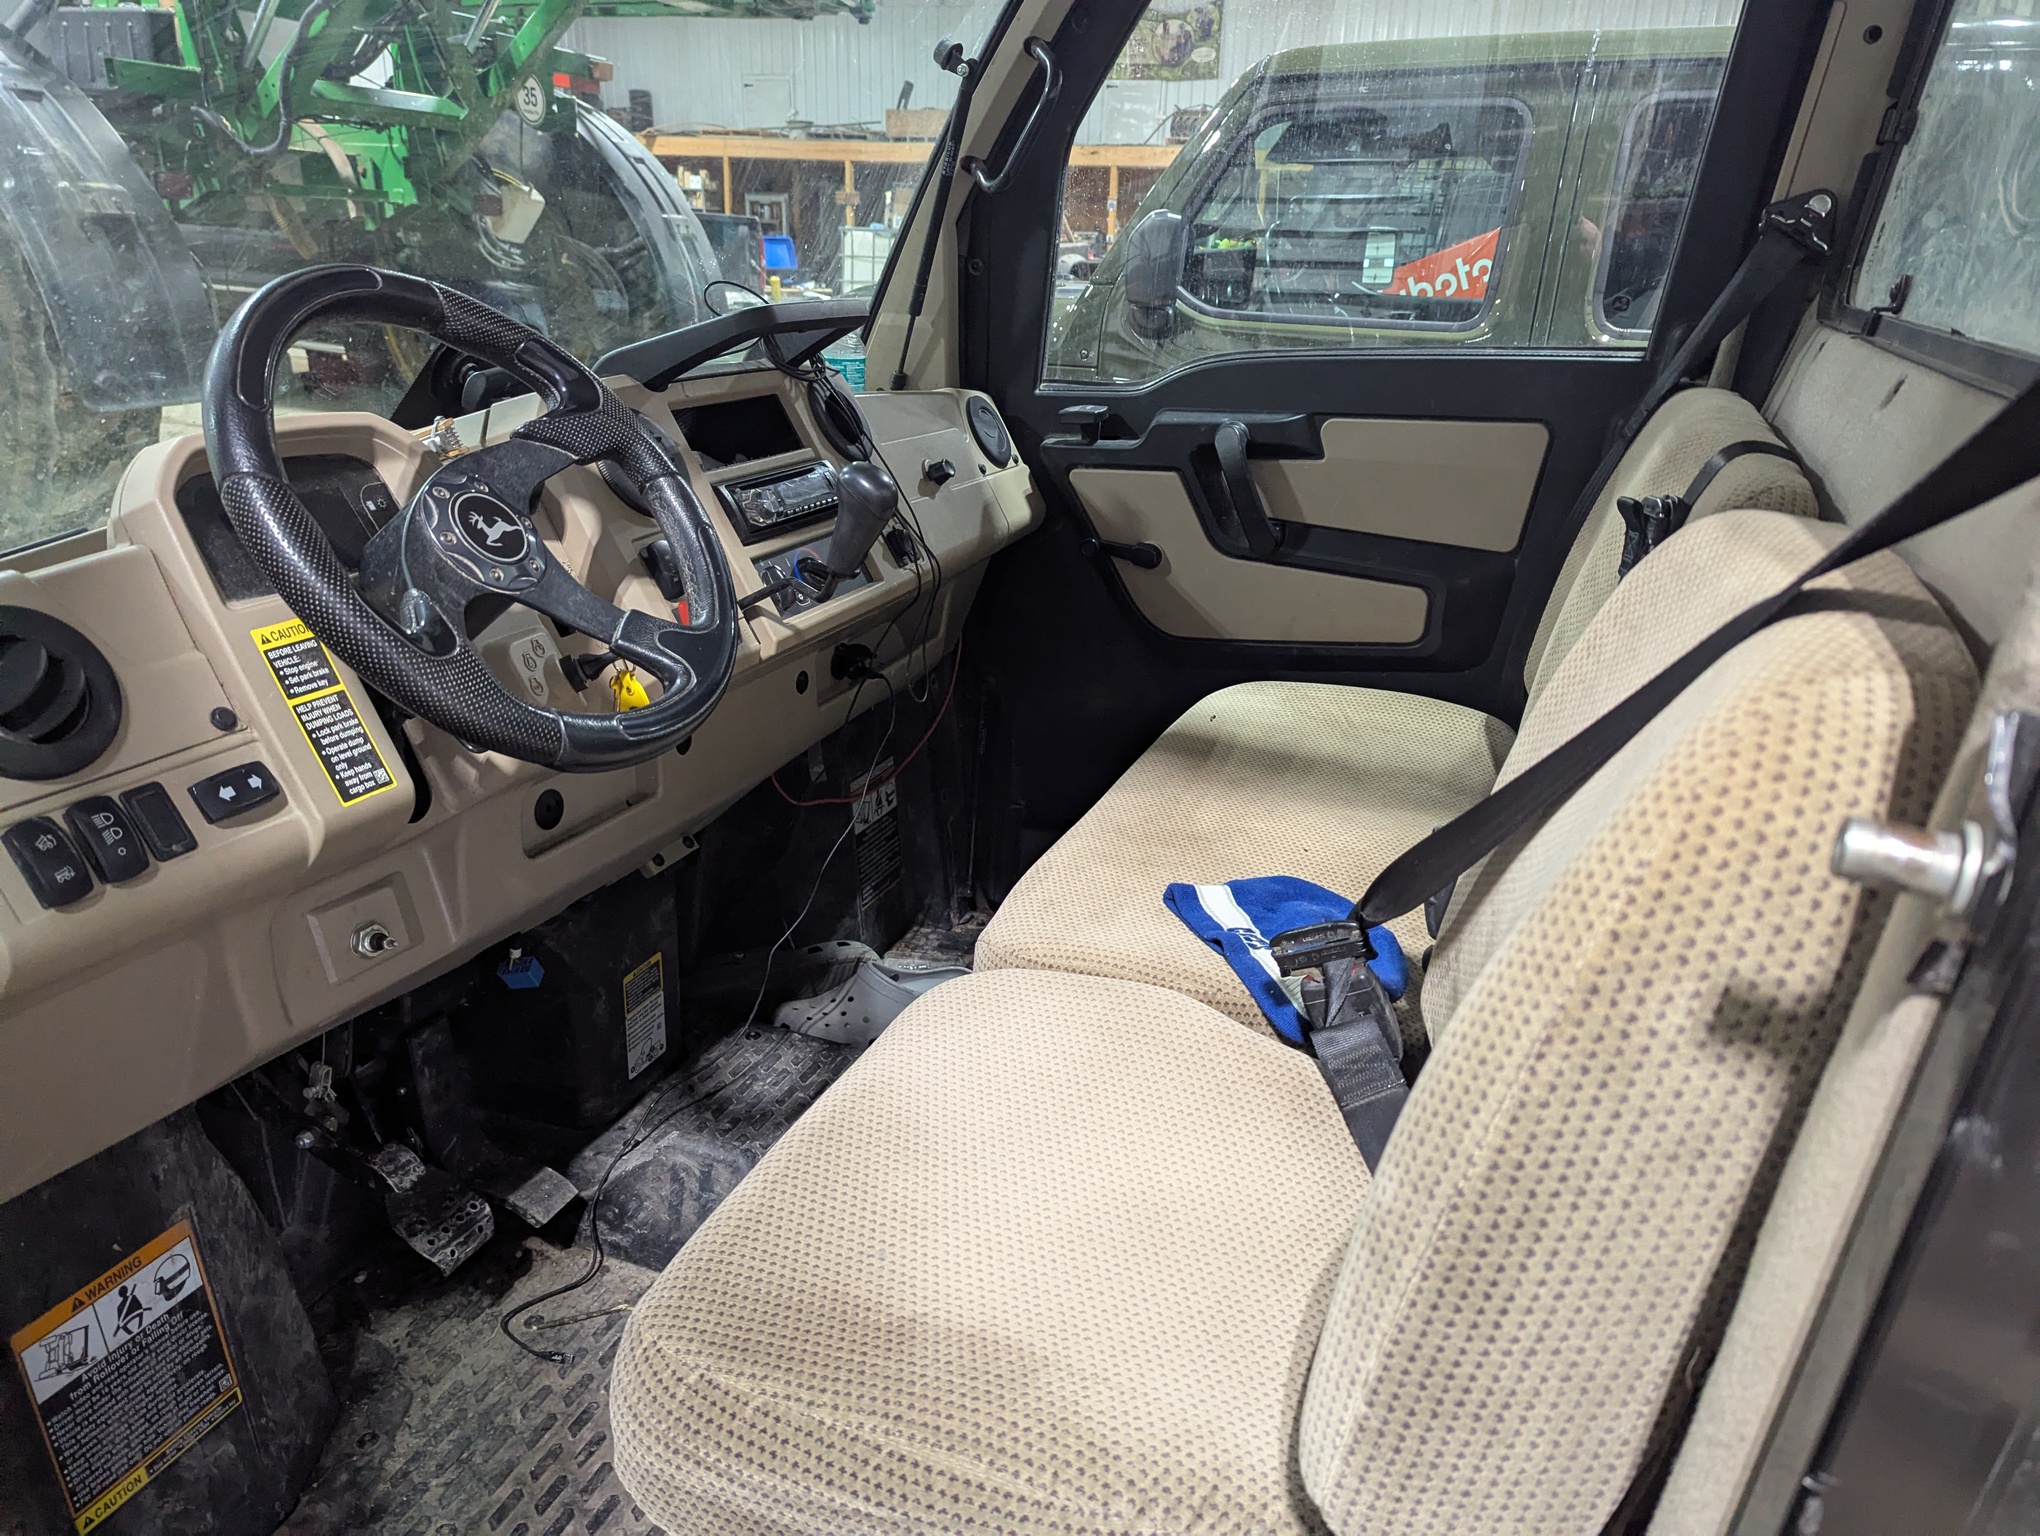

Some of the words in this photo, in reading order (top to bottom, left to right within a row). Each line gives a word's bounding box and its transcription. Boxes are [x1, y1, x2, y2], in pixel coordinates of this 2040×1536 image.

[523, 85, 538, 107] 35
[271, 623, 309, 642] CAUTIO
[268, 647, 293, 659] BEFORE
[292, 640, 317, 652] LEAVING
[284, 667, 299, 675] Stop
[299, 661, 318, 671] engine
[289, 676, 300, 684] Set
[300, 672, 313, 682] park
[312, 668, 329, 677] brake
[294, 682, 318, 693] Remove
[296, 703, 312, 713] HELP
[312, 695, 338, 708] PREVENT
[301, 710, 322, 721] INJURY
[322, 704, 341, 714] WHEN
[306, 716, 333, 730] DUMPING
[333, 709, 353, 720] LOADS
[316, 728, 331, 737] Lock
[331, 723, 344, 733] park
[343, 719, 358, 727] brake
[320, 735, 339, 745] before
[339, 726, 364, 738] dumping
[326, 743, 348, 754] Operate
[348, 737, 364, 747] dump
[338, 750, 352, 760] level
[352, 743, 372, 756] ground
[335, 762, 348, 771] only
[340, 769, 355, 778] Keep
[354, 763, 372, 773] hands
[345, 777, 359, 786] away
[359, 772, 373, 780] from
[349, 784, 365, 794] cargo
[364, 780, 376, 788] box
[86, 1257, 141, 1300] WARNING
[70, 1382, 91, 1400] from
[93, 1353, 128, 1383] Rollover
[131, 1345, 139, 1354] or
[142, 1323, 170, 1346] Falling
[171, 1311, 183, 1324] Off
[82, 1359, 106, 1382] Avoid
[108, 1341, 133, 1362] Injury
[135, 1333, 143, 1342] or
[146, 1314, 169, 1334] Death
[95, 1475, 141, 1518] CAUTION
